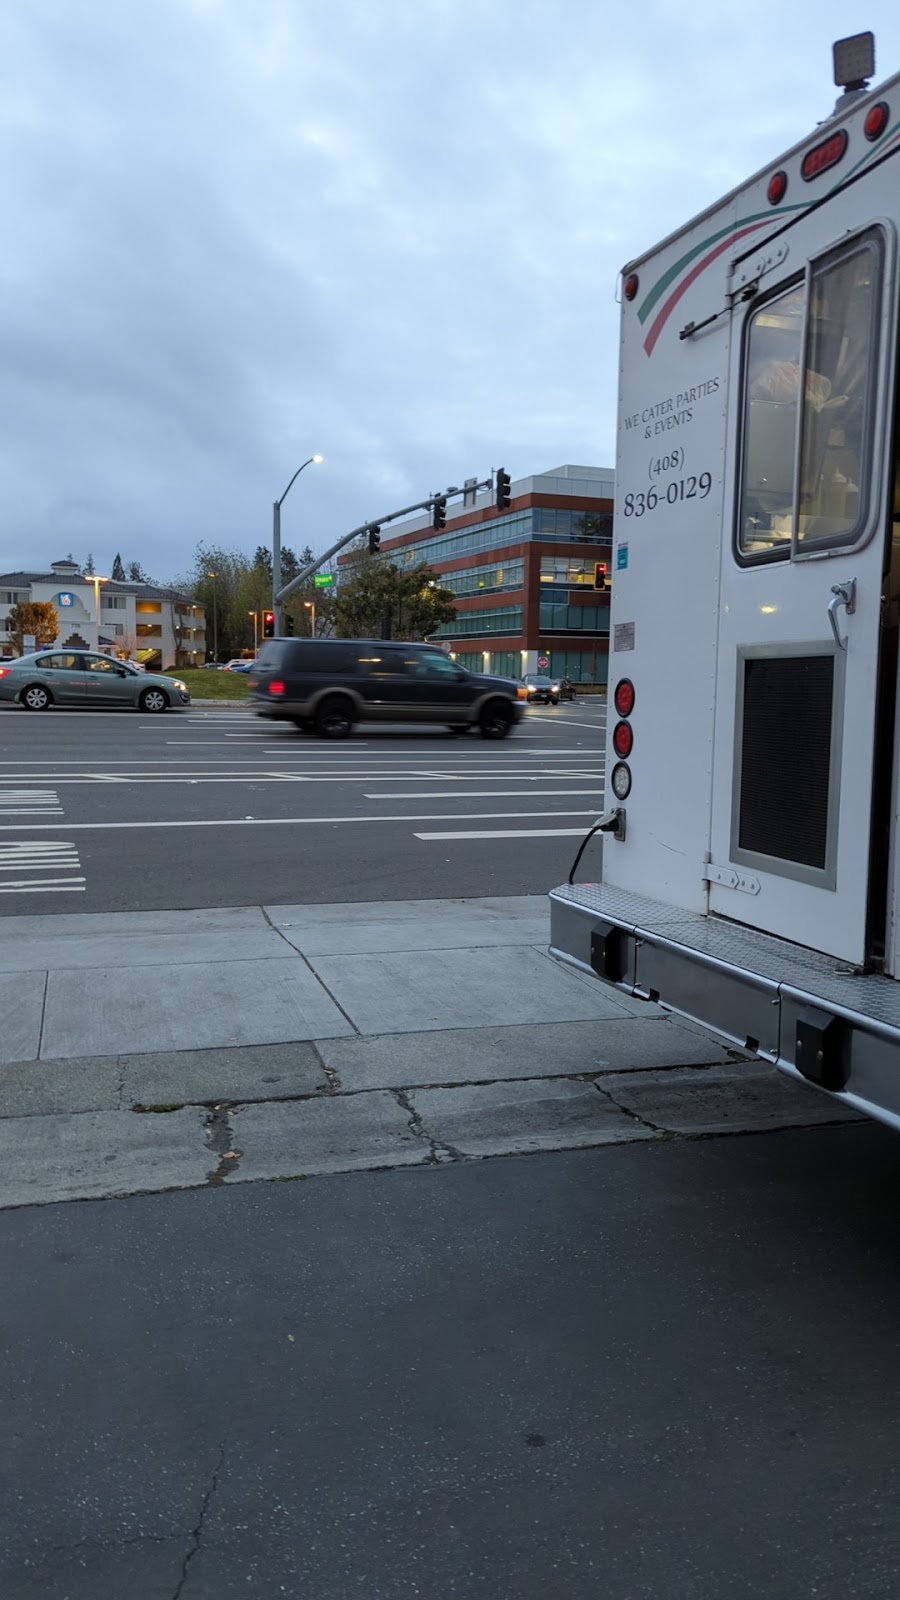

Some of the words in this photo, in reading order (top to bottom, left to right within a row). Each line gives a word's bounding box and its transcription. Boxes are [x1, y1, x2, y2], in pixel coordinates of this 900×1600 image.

[624, 414, 640, 430] WE
[641, 398, 673, 423] CATER
[676, 376, 720, 408] PARTIES
[644, 425, 652, 439] &
[654, 407, 693, 435] EVENTS
[648, 446, 685, 481] (408)
[623, 471, 712, 518] 836-0129
